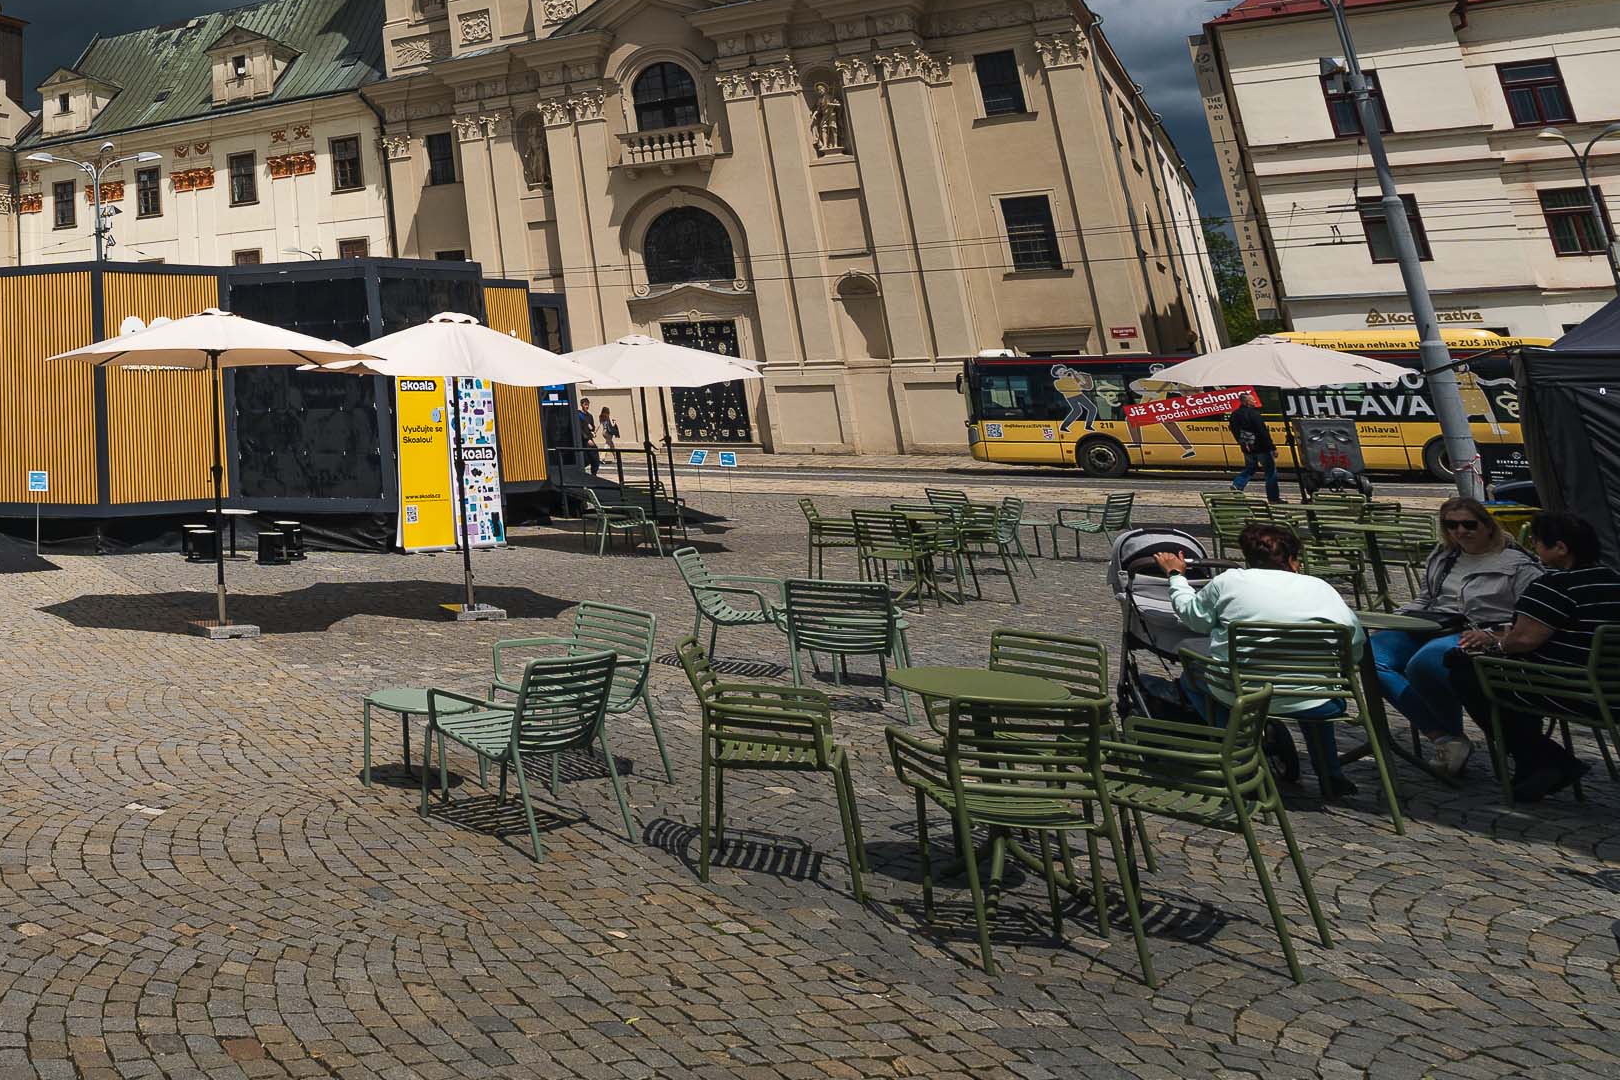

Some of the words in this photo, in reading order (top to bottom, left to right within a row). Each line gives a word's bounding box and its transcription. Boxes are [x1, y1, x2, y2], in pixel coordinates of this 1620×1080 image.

[1243, 226, 1259, 267] BRÁNA
[1386, 310, 1483, 323] Koorativa
[1337, 340, 1365, 349] hlava
[1366, 340, 1404, 349] nehlava
[1458, 338, 1481, 347] ZUŠ
[1482, 338, 1523, 348] Jihlava!
[401, 381, 434, 390] skoala
[1129, 404, 1148, 417] Již
[1148, 402, 1170, 414] 13.
[1171, 399, 1185, 410] 6.
[1285, 395, 1435, 416] JIHLAVA
[1155, 409, 1190, 422] spodní
[1191, 401, 1233, 415] náměstí
[402, 425, 433, 434] Vyučujte
[1099, 422, 1115, 430] 218
[1186, 423, 1220, 433] Slavme
[1359, 425, 1400, 434] Jihlava!
[403, 435, 433, 444] Skoalou!
